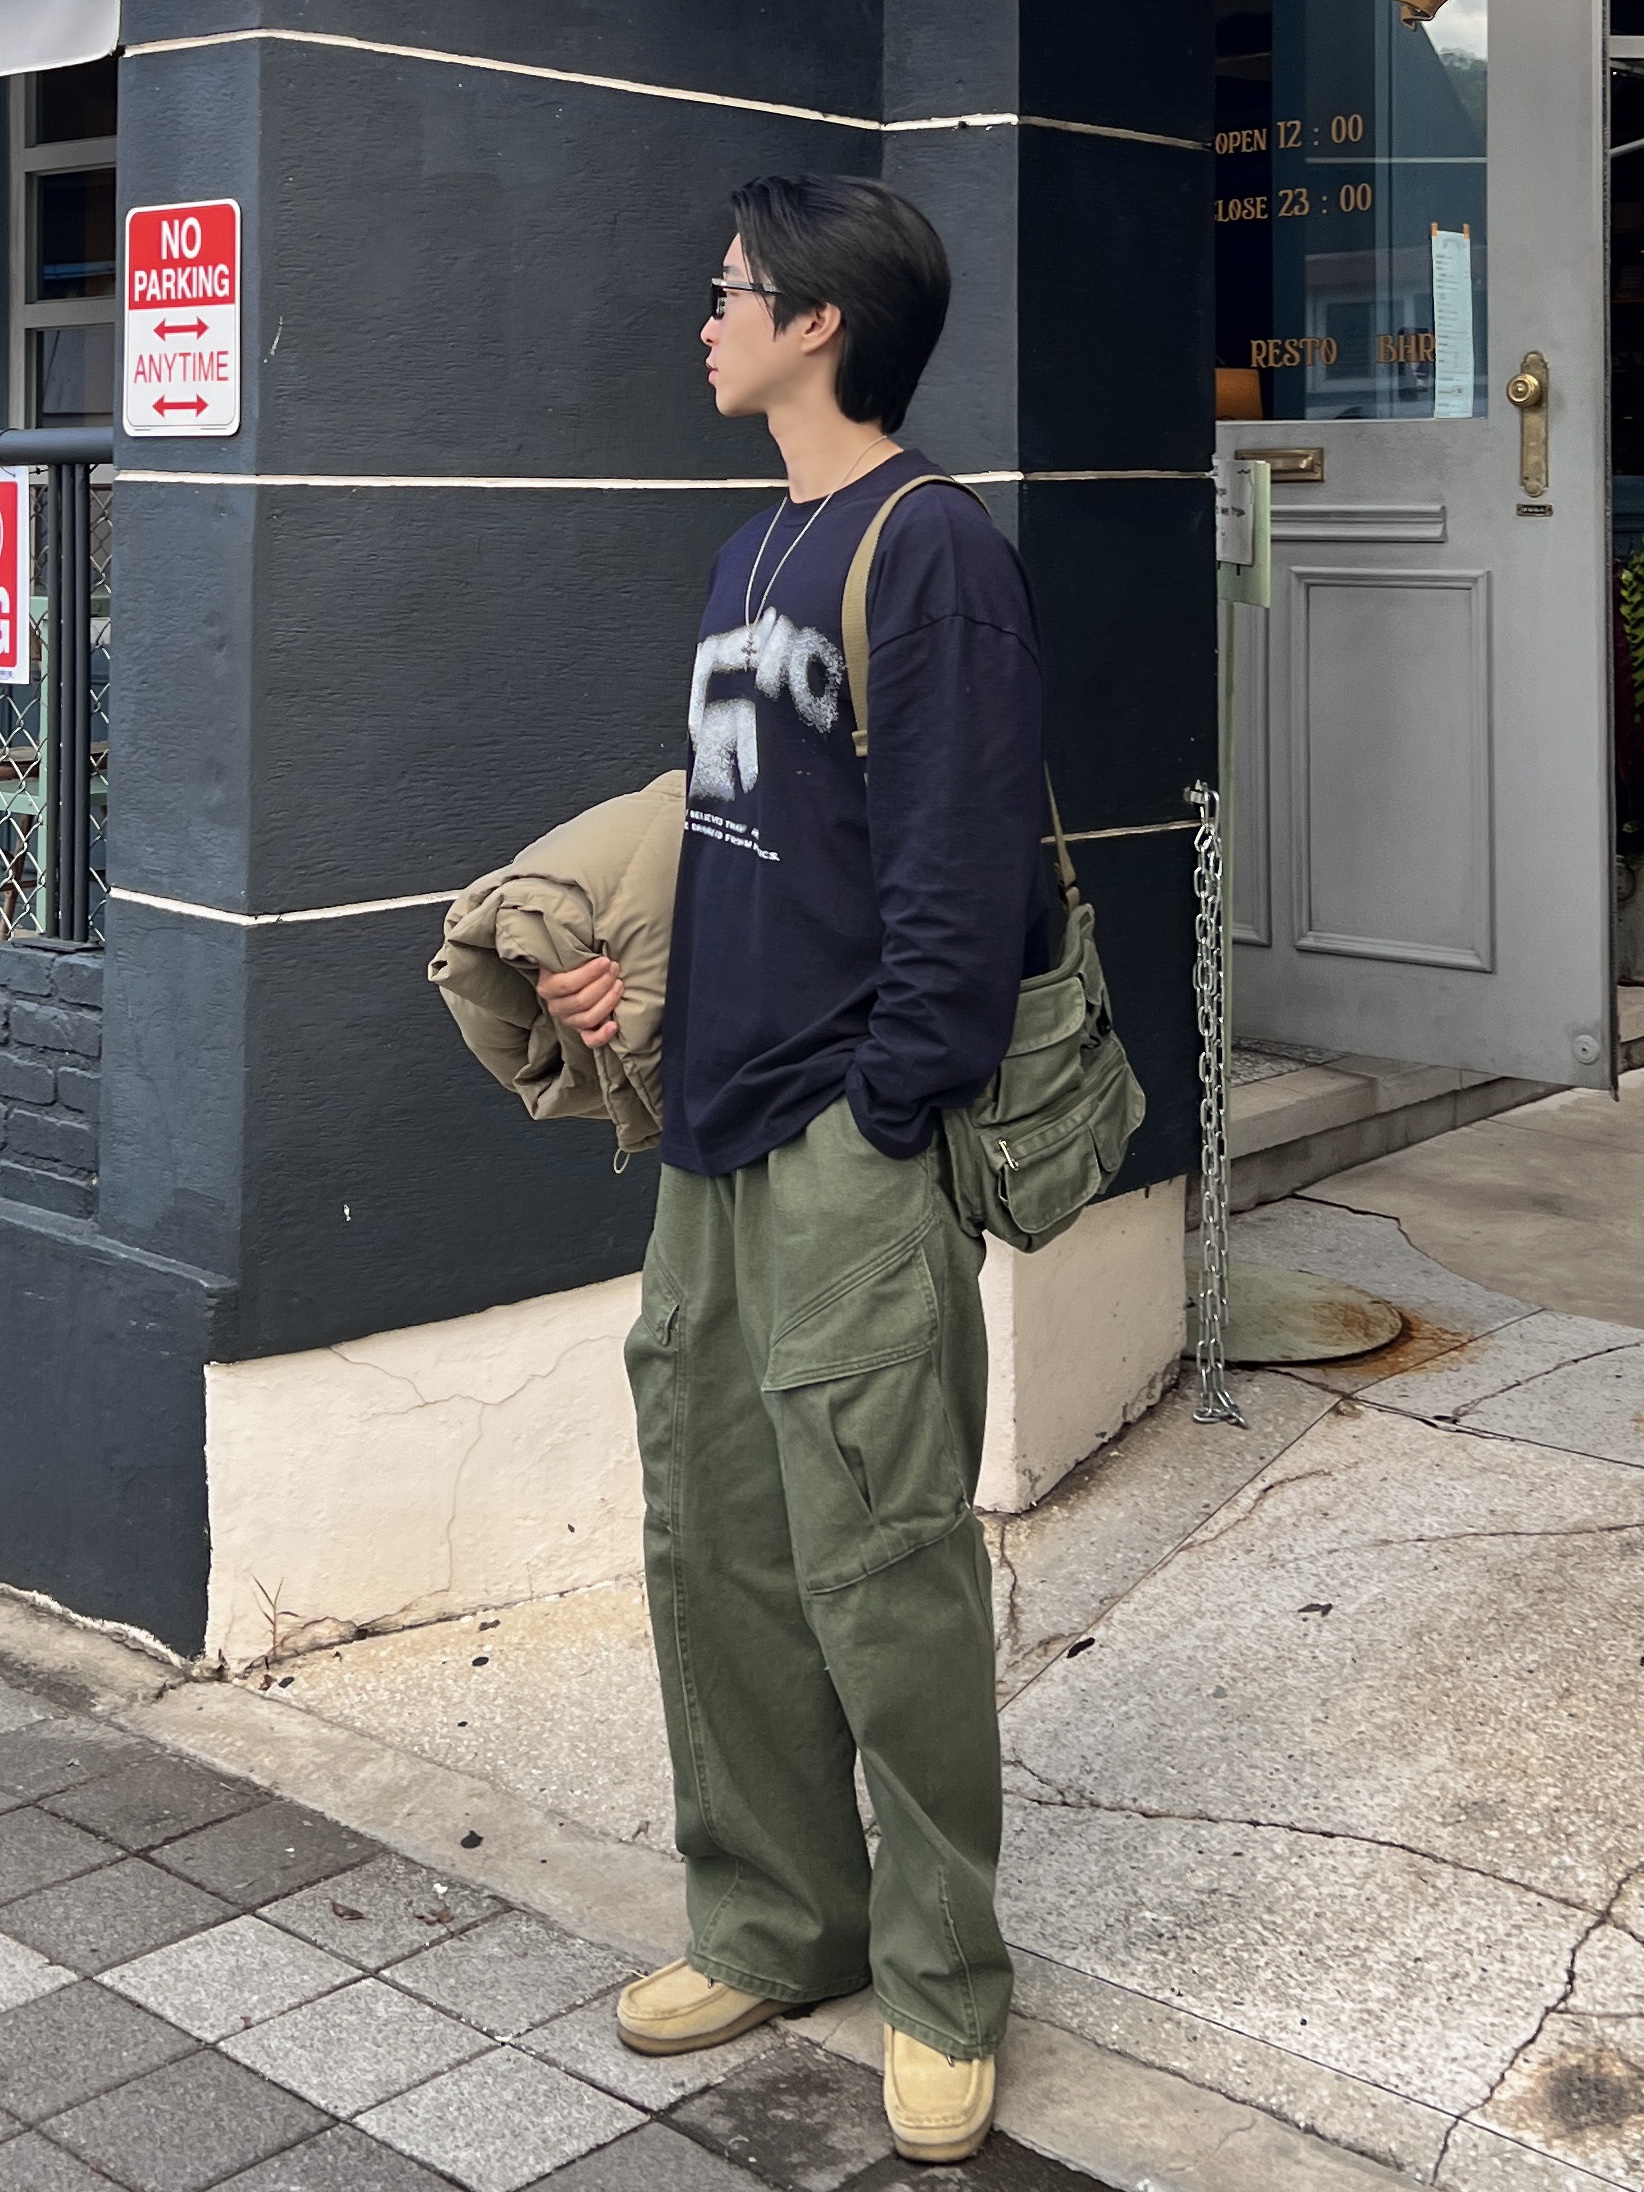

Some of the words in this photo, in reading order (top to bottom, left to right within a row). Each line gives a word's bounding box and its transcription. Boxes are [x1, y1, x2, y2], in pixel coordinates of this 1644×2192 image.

[1214, 128, 1268, 155] OPEN
[1276, 119, 1303, 149] 12
[1330, 113, 1364, 144] 00
[1214, 196, 1269, 223] LOSE
[1278, 188, 1311, 217] 23
[1339, 183, 1373, 213] 00
[160, 216, 202, 260] NO
[133, 263, 230, 303] PARKING
[133, 350, 230, 384] ANYTIME
[1250, 336, 1339, 369] RESTO
